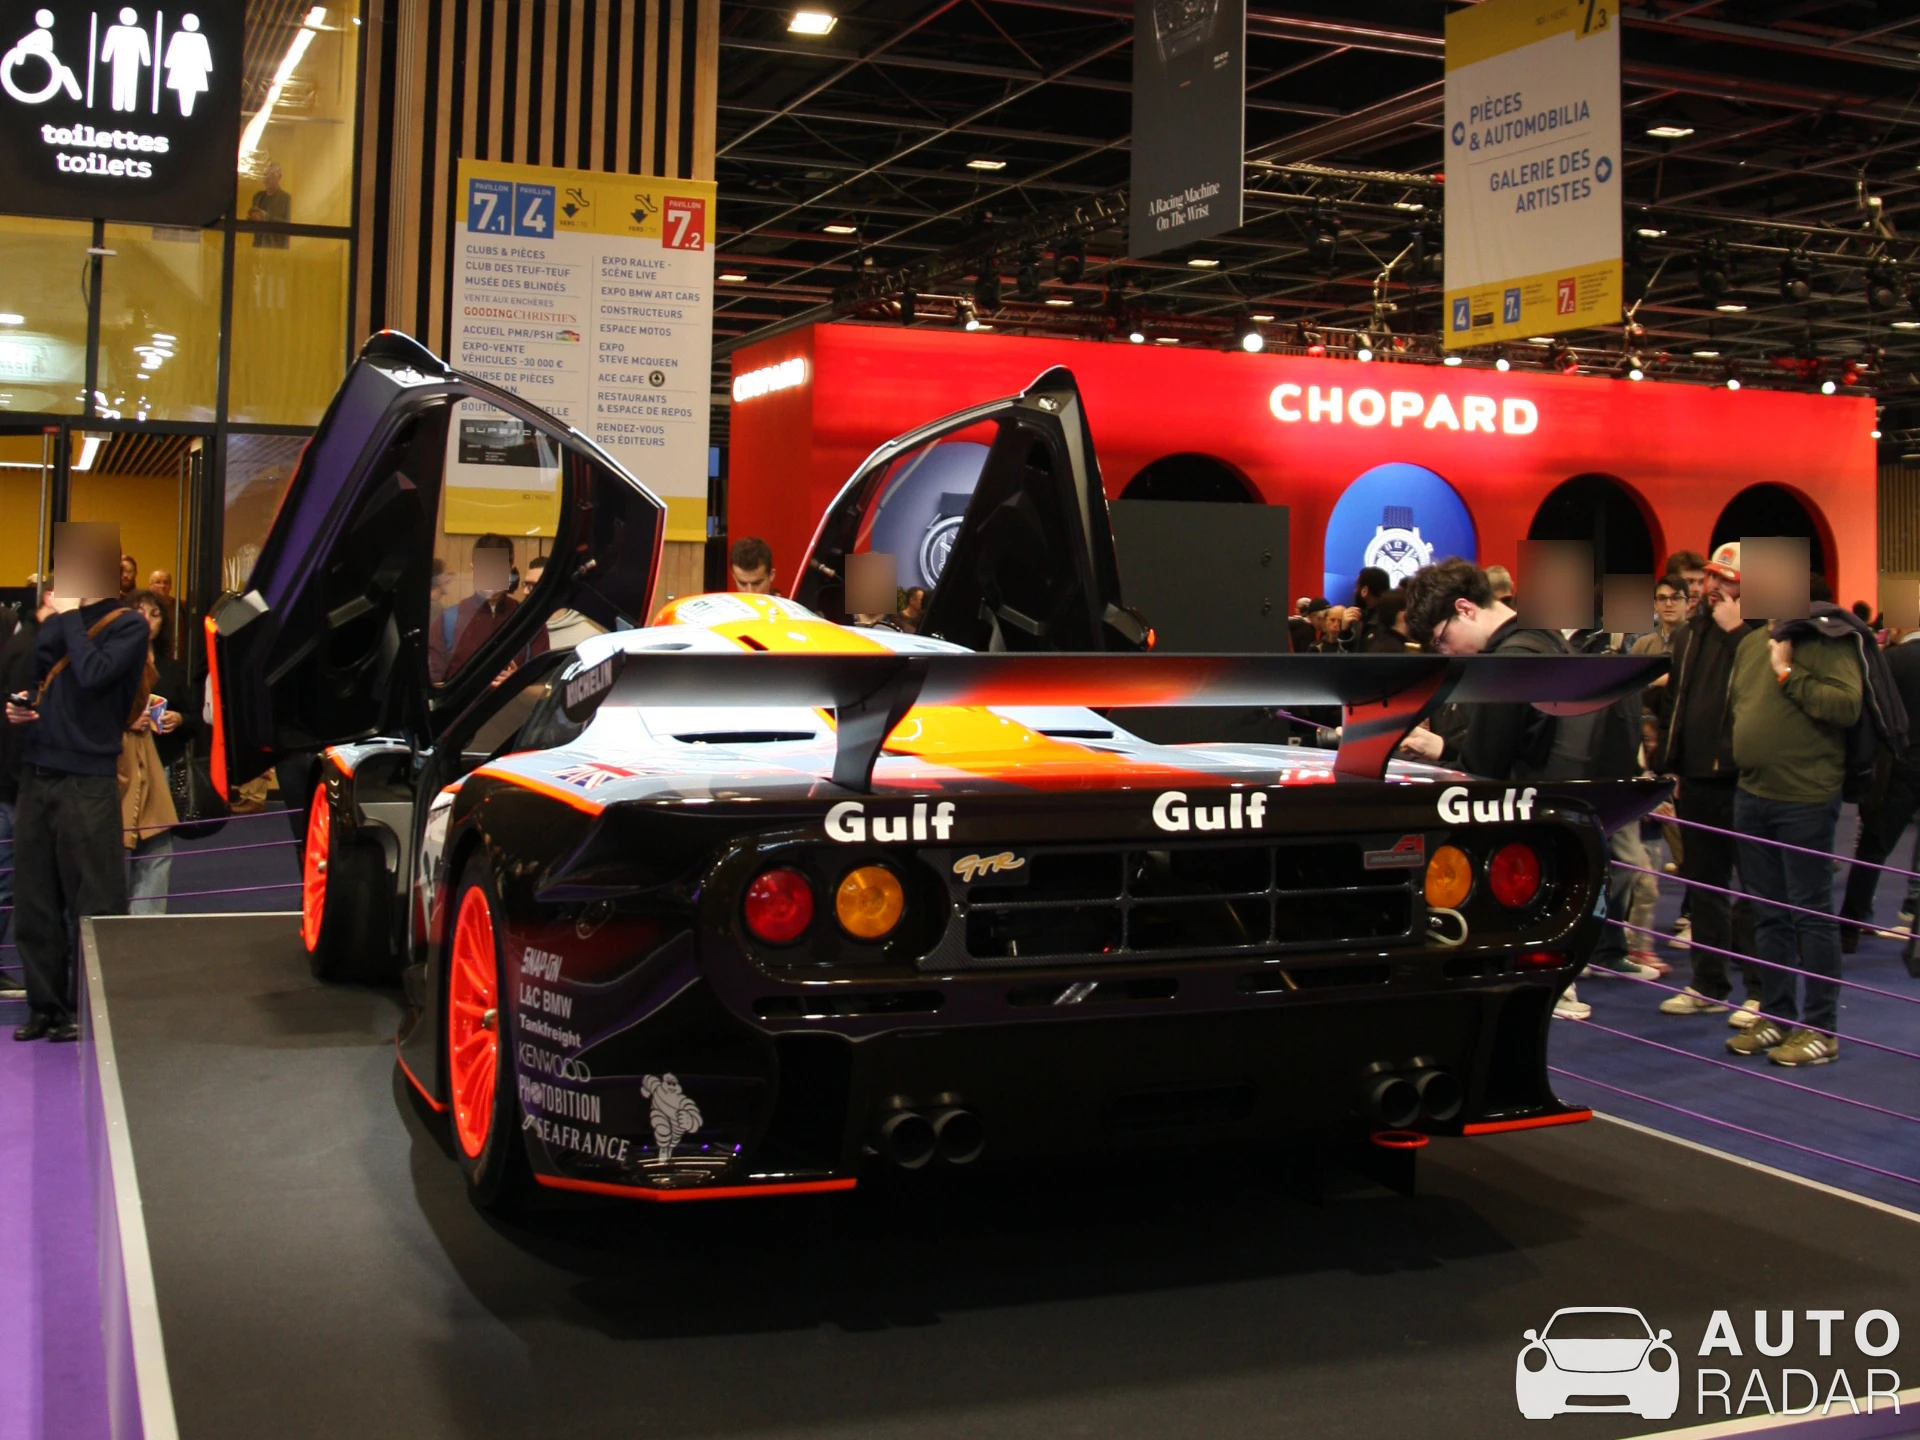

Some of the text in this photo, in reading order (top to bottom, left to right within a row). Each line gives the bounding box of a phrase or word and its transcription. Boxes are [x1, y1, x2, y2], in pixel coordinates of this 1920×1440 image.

[1470, 92, 1522, 124] PIÈCES
[1469, 100, 1591, 151] & AUTOMOBILIA
[41, 123, 170, 154] toilettes
[56, 152, 153, 178] toilets
[1490, 148, 1591, 192] GALERIE DES
[475, 182, 509, 192] PAVILLON
[520, 187, 551, 196] PAVILLON
[1516, 177, 1591, 213] ARTISTES
[669, 200, 701, 209] PAVILLON
[1148, 182, 1220, 216] A Racing Machine
[473, 192, 505, 232] 7.1
[522, 198, 547, 233] 4
[1156, 204, 1209, 231] On The Wrist
[667, 209, 701, 249] 7.2
[466, 245, 545, 259] CLUBS & PIÈCES
[465, 261, 571, 277] CLUB DES TEUF-TEUF
[602, 255, 627, 265] EXPO
[629, 258, 665, 269] RALLYE
[601, 267, 657, 280] SCÈNE LIVE
[465, 276, 566, 292] MUSÉE DES BLINDÉS
[464, 293, 490, 302] VENTE
[511, 296, 554, 307] ENCHÈRES
[601, 286, 700, 302] EXPO BMW ART CARS
[1559, 286, 1574, 313] 7.2
[464, 306, 512, 319] GOODING
[600, 305, 683, 319] CONSTRUCTEURS
[1456, 305, 1467, 328] 4
[463, 325, 553, 339] ACCUEIL PMR/PSH
[600, 324, 671, 336] ESPACE MOTOS
[463, 341, 525, 354] EXPO-VENTE
[599, 342, 624, 352] EXPO
[462, 353, 517, 365] VÉHICULES
[537, 359, 554, 368] 000
[556, 360, 563, 369] €
[598, 354, 678, 367] STEVE MCQUEEN
[504, 372, 517, 382] DE
[520, 372, 555, 384] PIÈCES
[598, 373, 644, 384] ACE CAFE
[598, 391, 667, 404] RESTAURANTS
[597, 404, 692, 417] & ESPACE DE REPOS
[1269, 383, 1539, 435] CHOPARD
[597, 422, 665, 435] RENDEZ-VOUS
[596, 434, 665, 446] DES ÉDITEURS
[566, 659, 612, 709] MICHELIN
[1152, 791, 1267, 832] Gulf
[1437, 786, 1537, 824] Gulf
[824, 801, 956, 842] Gulf
[953, 851, 1025, 883] GTR
[519, 982, 573, 1020] L&C BMW
[519, 1013, 582, 1049] Tankfreight
[518, 1041, 591, 1083] KENWOOD
[519, 1074, 600, 1124] PHOTOBITION
[537, 1116, 630, 1162] SEAFRANCE
